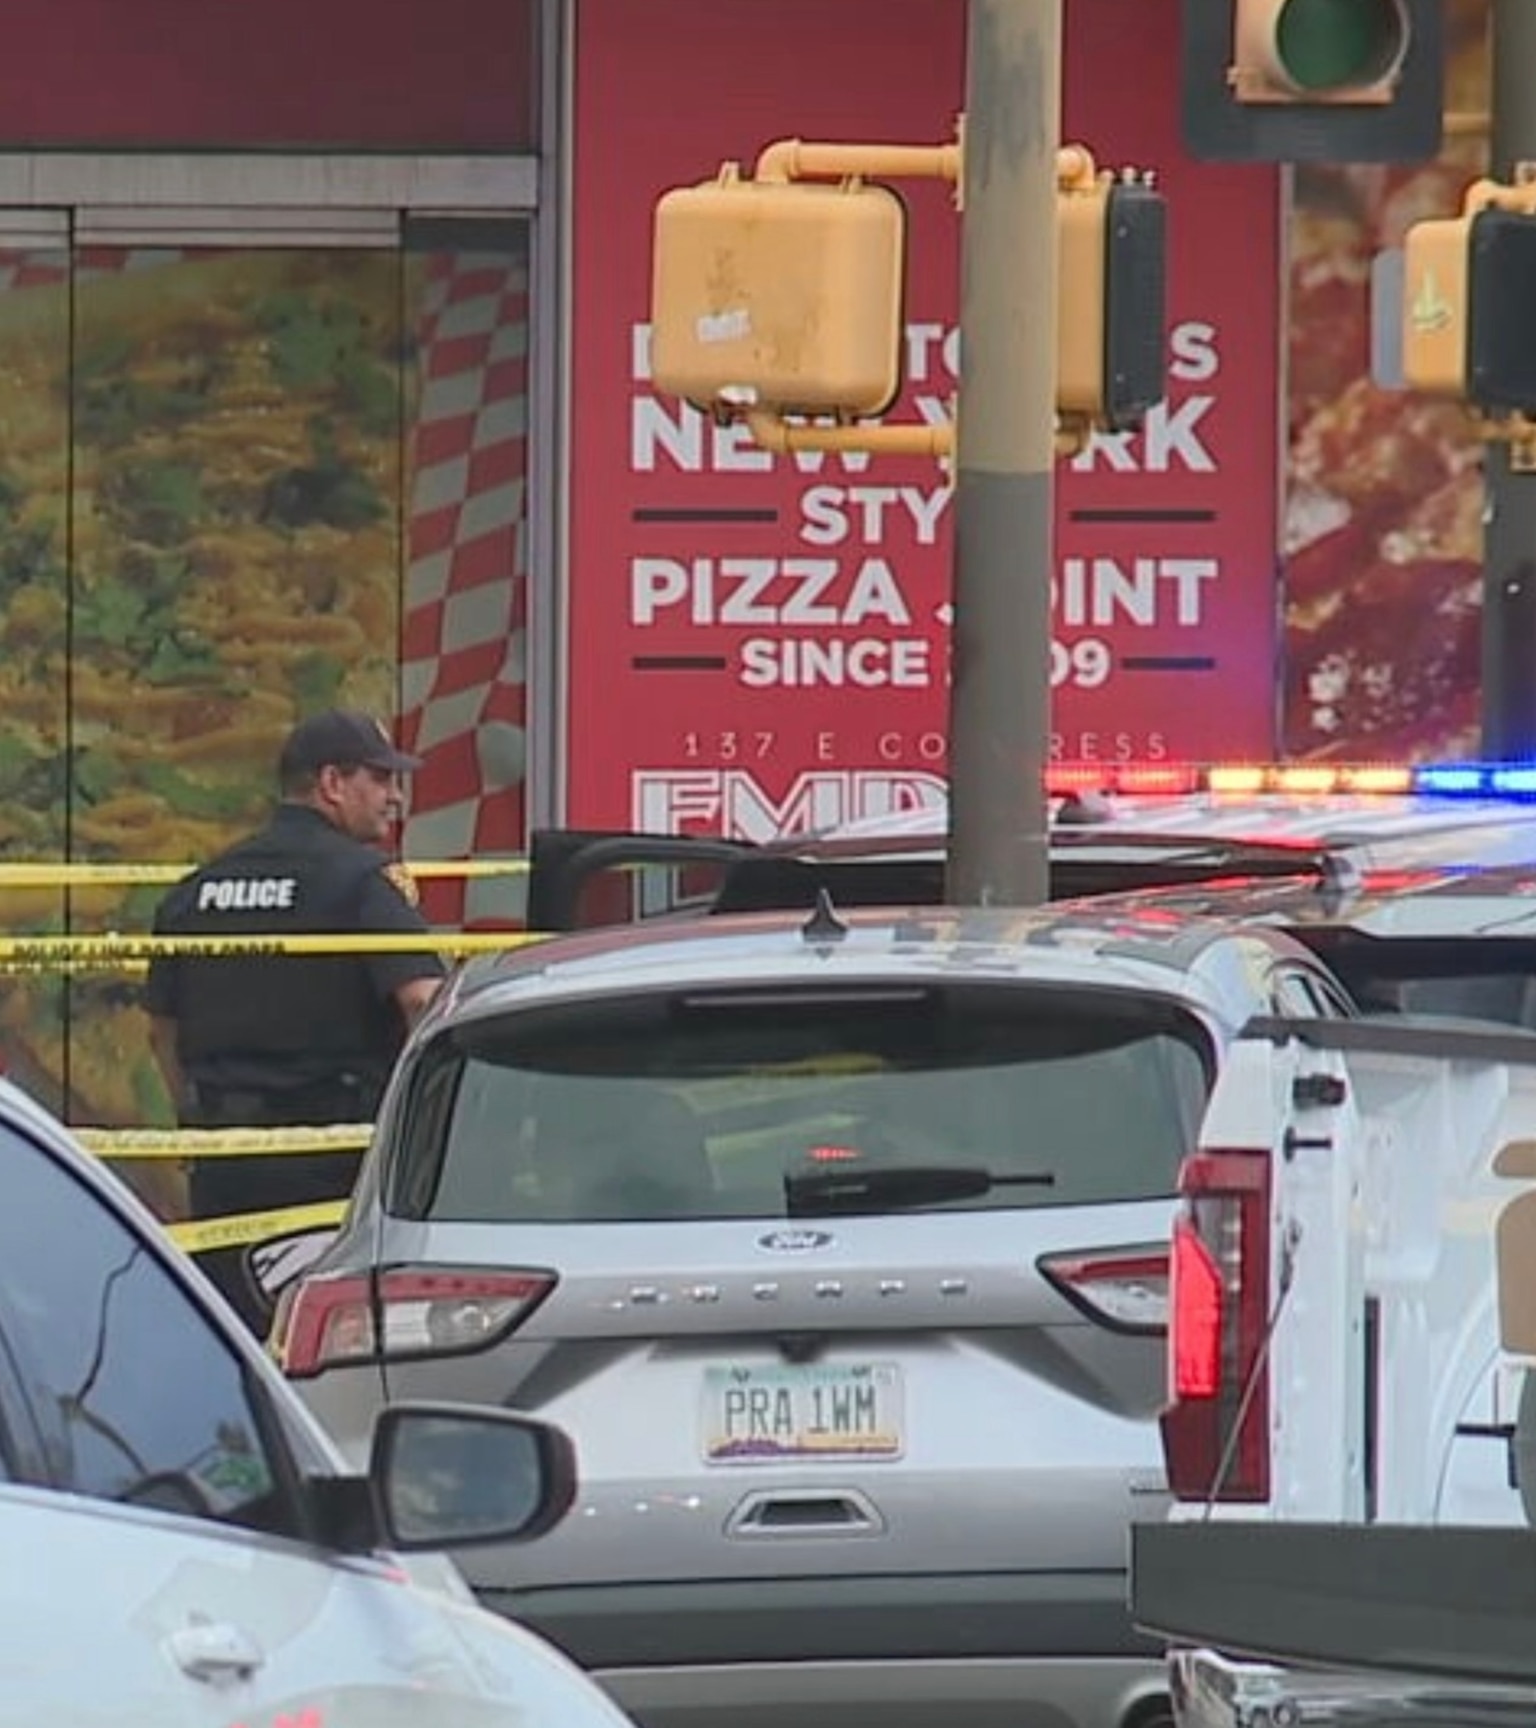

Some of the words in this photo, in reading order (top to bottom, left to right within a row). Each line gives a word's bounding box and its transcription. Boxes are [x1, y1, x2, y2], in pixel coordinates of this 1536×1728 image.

[632, 558, 910, 627] PIZZA
[934, 558, 1218, 627] INT
[740, 638, 930, 688] SINCE
[684, 732, 773, 760] 137
[818, 732, 835, 760] E
[879, 732, 1166, 760] CORESS
[199, 878, 296, 910] POLICE
[725, 1387, 792, 1437] PRA
[808, 1385, 876, 1434] 1WM
